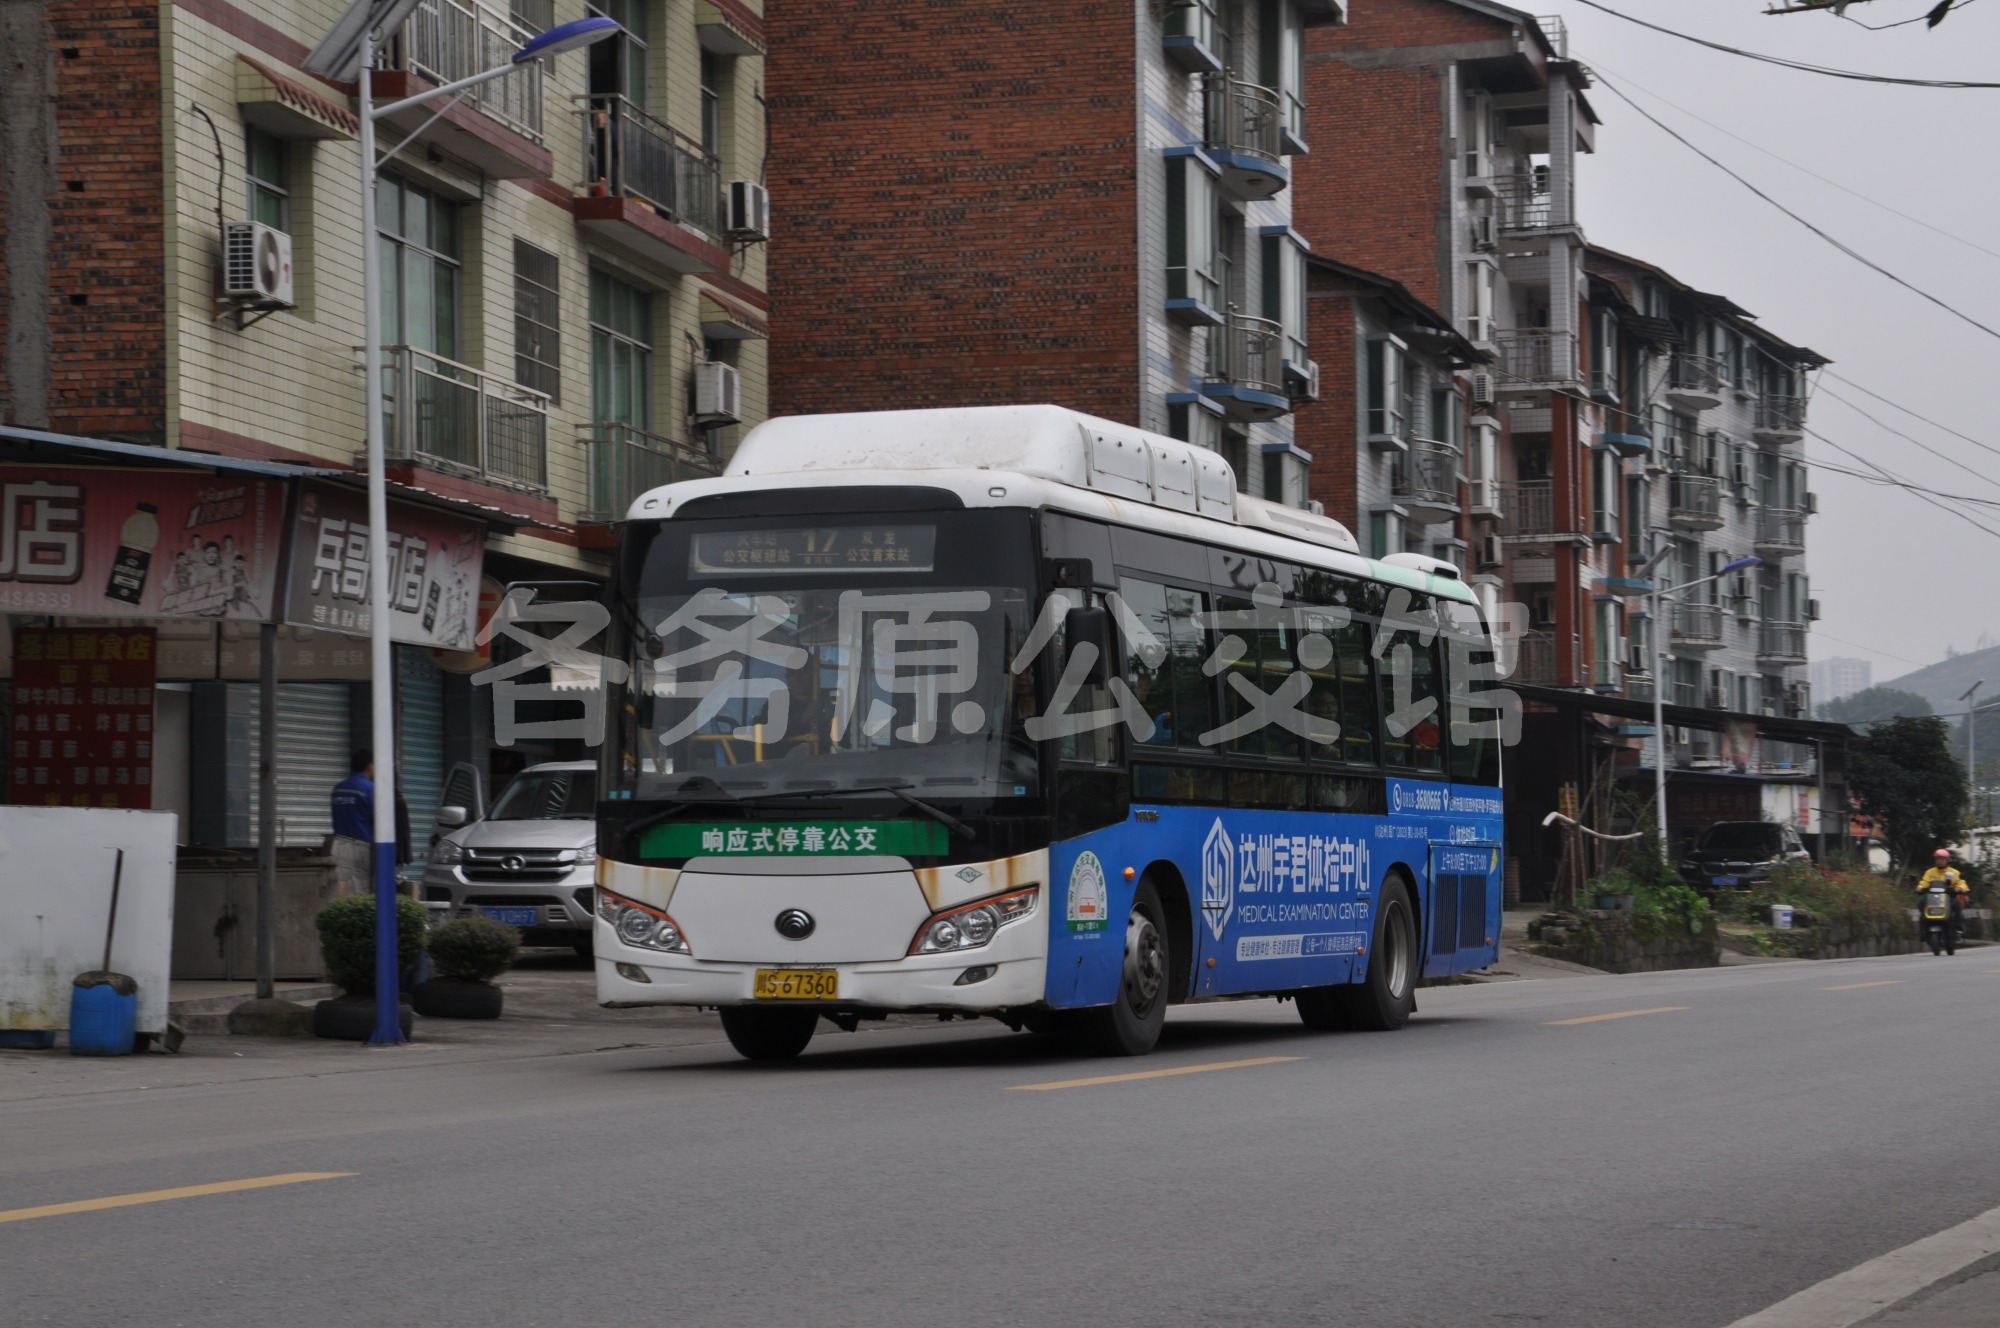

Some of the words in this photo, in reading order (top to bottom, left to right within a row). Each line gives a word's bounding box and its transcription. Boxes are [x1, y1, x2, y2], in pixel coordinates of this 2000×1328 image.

[0, 481, 80, 577] 店
[802, 528, 838, 552] 17
[846, 548, 910, 562] 公交首末站
[702, 826, 878, 853] 响应式停靠公交
[1239, 833, 1370, 893] 达州宇君体检中心
[1238, 904, 1277, 923] MEDICAL
[1279, 903, 1336, 922] EXAMINATION
[1339, 902, 1369, 919] CENTER
